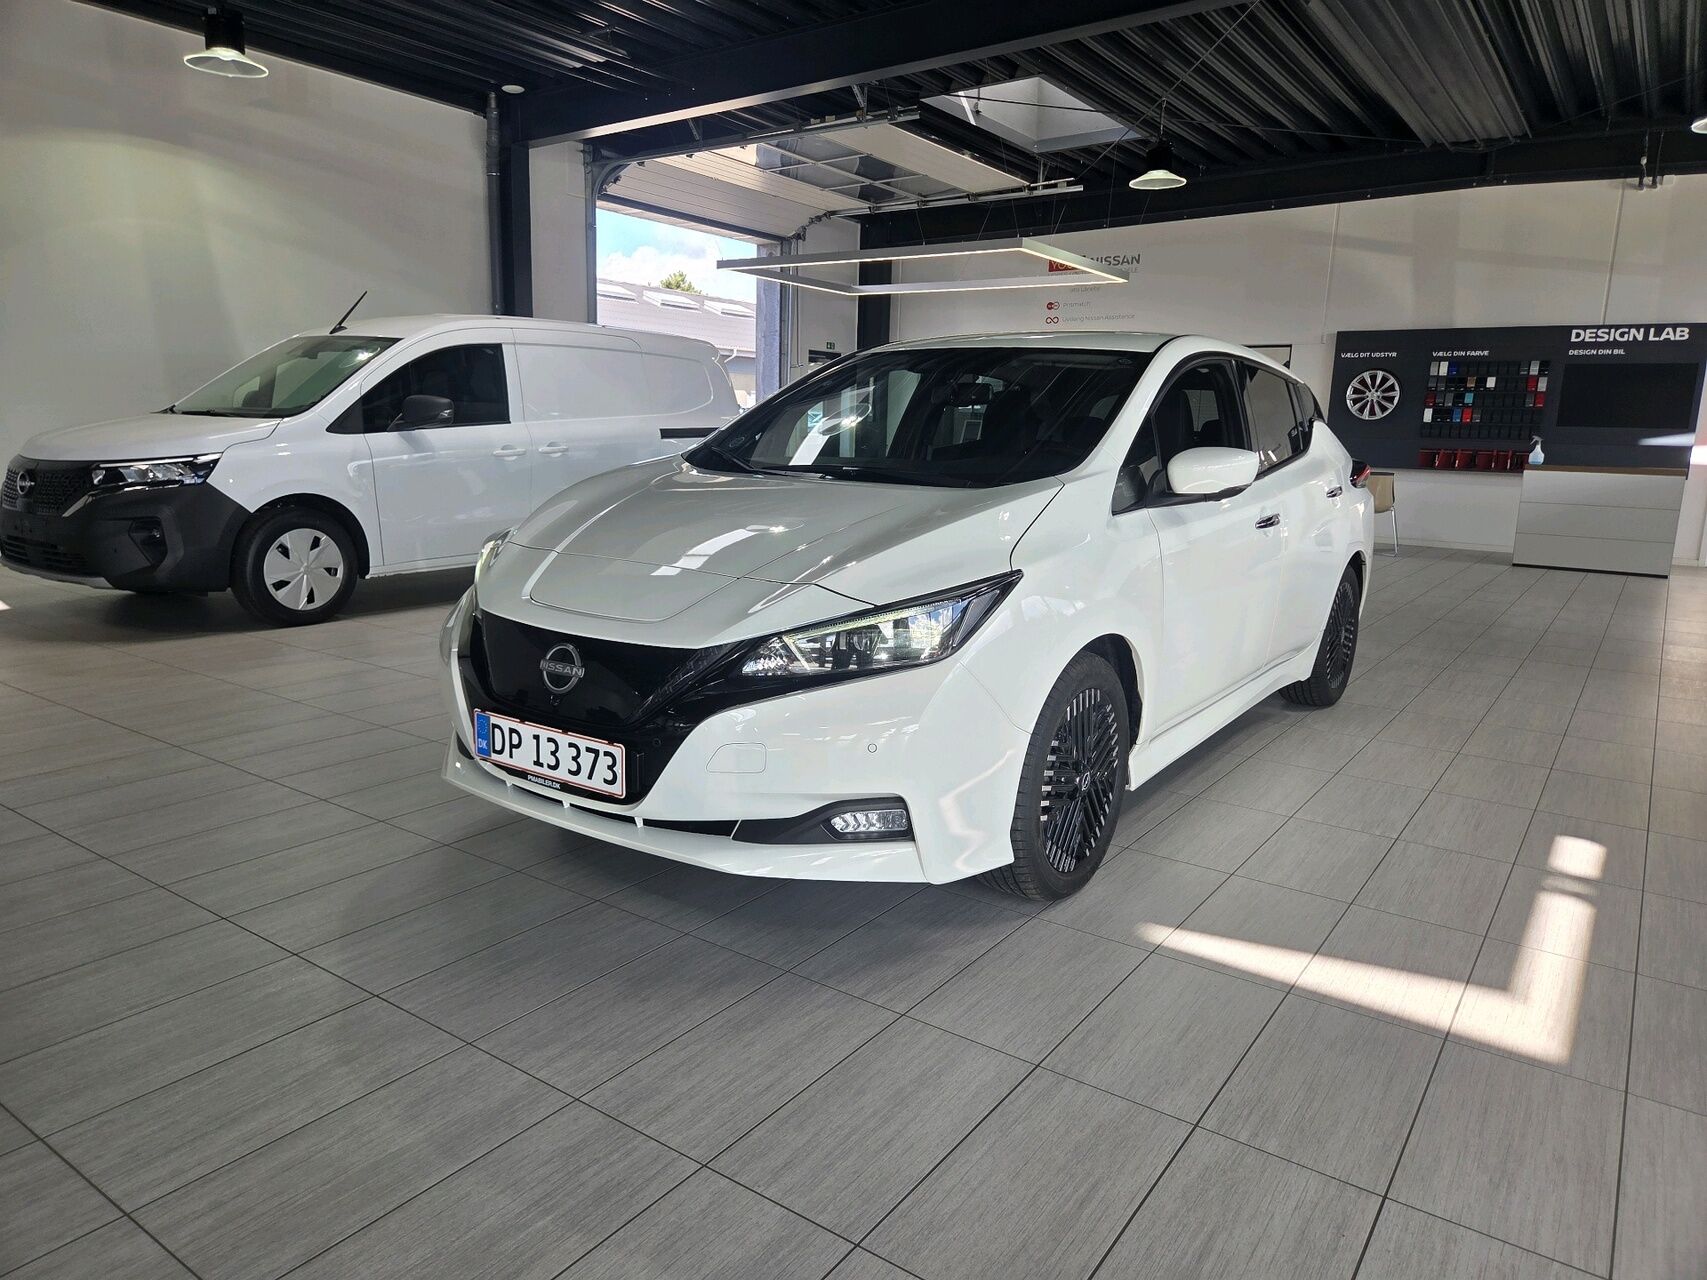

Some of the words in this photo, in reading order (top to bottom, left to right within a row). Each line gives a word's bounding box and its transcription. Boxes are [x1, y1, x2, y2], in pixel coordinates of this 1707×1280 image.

[1090, 253, 1141, 266] ISSAN
[1570, 328, 1645, 342] DESIGN
[1648, 327, 1690, 341] LAB
[540, 659, 583, 678] NISSAN
[478, 739, 488, 750] DK
[491, 722, 522, 759] DP
[532, 734, 560, 771] 13
[567, 741, 618, 786] 373
